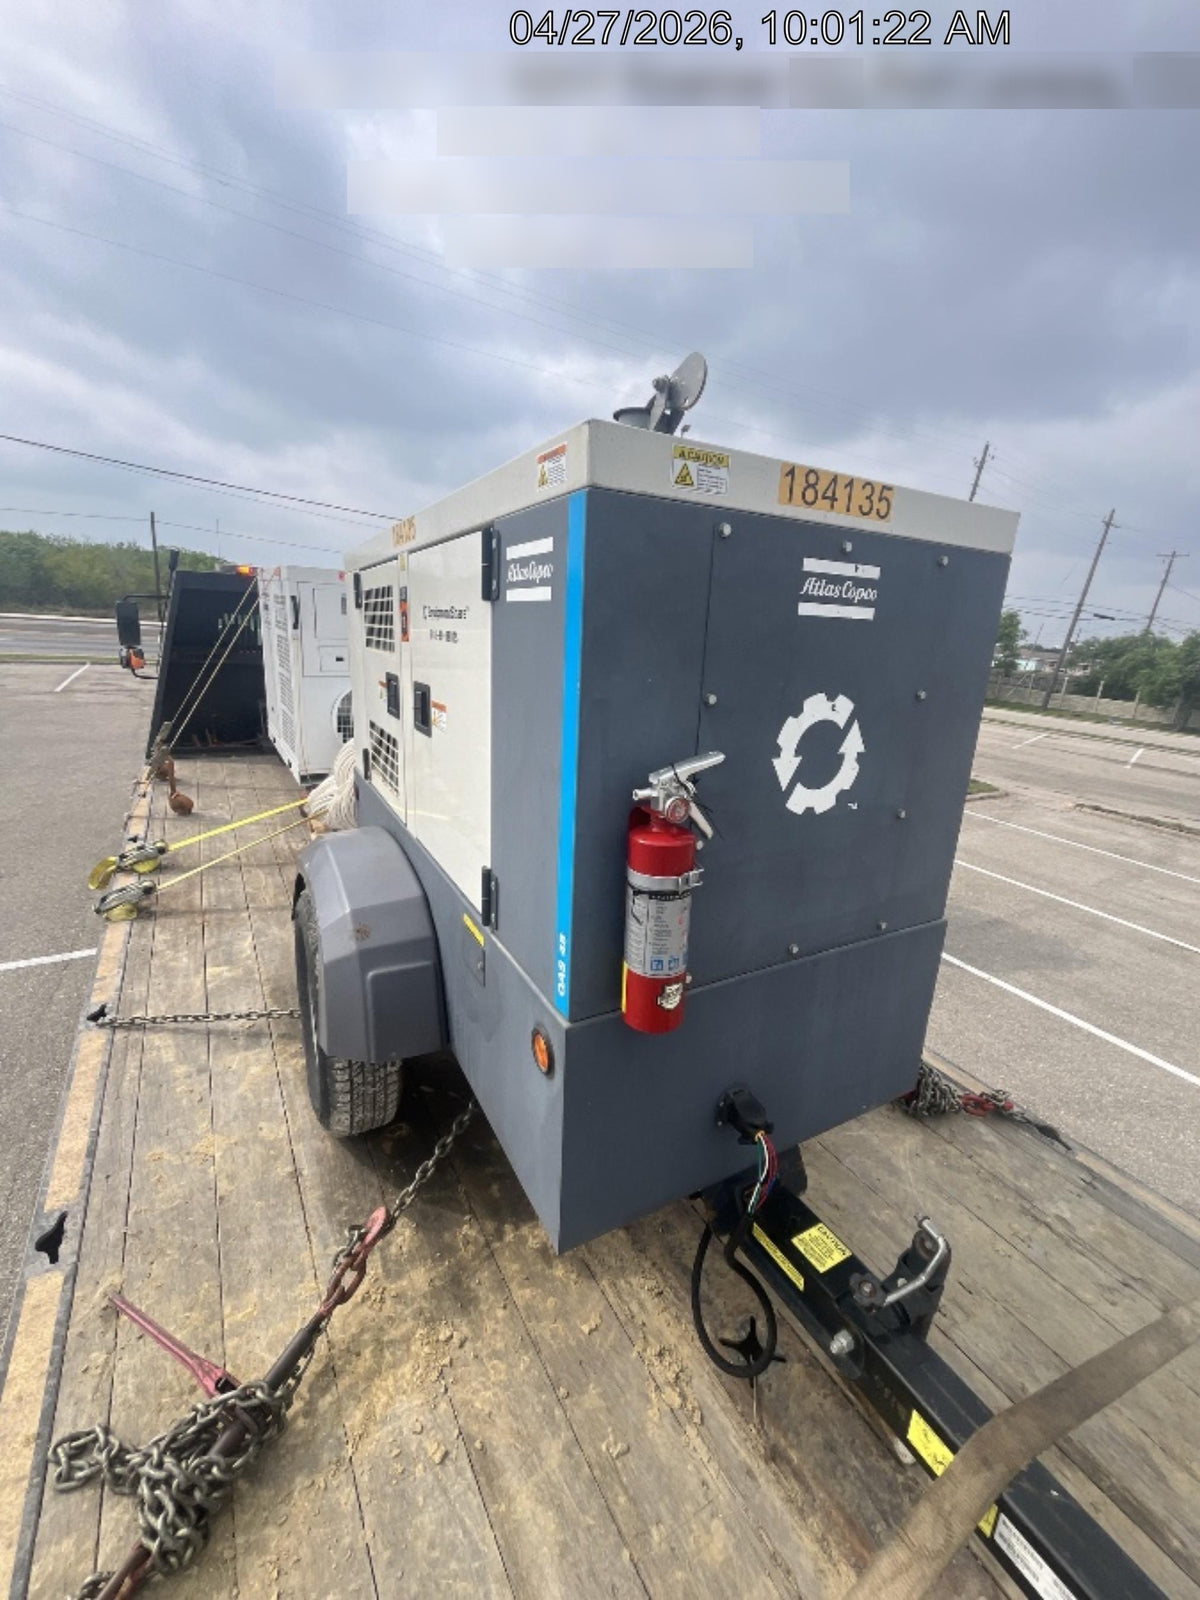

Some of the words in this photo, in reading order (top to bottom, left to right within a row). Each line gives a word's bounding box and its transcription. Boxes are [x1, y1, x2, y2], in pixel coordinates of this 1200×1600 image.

[784, 465, 894, 519] 184135
[506, 563, 529, 583] Atlas
[799, 577, 841, 598] Atlas
[842, 580, 878, 604] Copco
